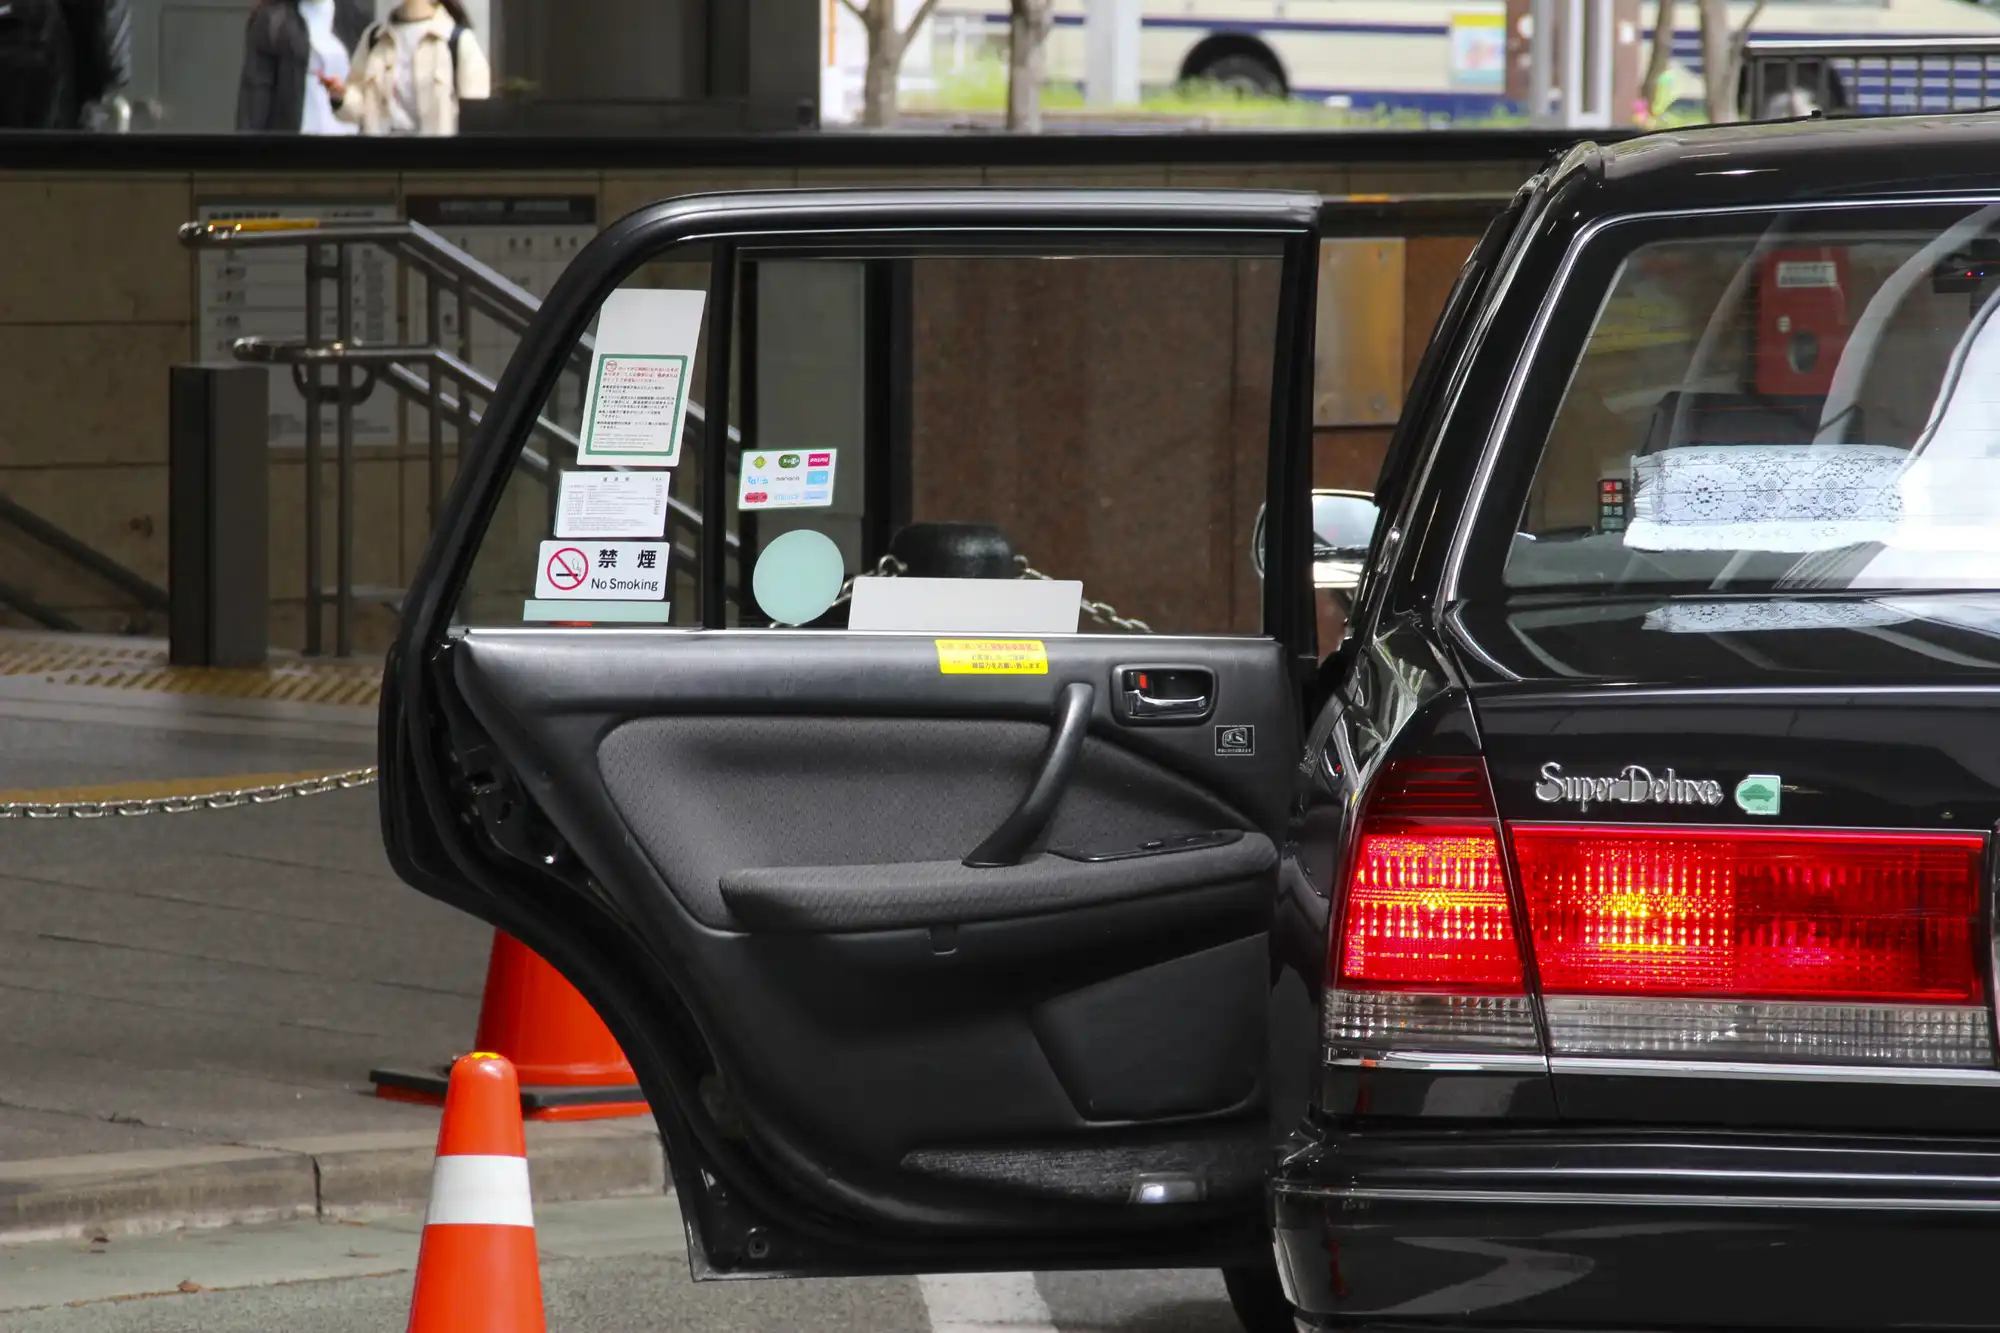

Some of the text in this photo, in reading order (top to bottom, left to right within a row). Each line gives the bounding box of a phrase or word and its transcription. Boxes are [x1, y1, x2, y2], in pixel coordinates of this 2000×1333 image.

[598, 549, 657, 568] 禁煙
[591, 577, 658, 592] No Smoking
[1535, 762, 1725, 813] Super Deluxe
